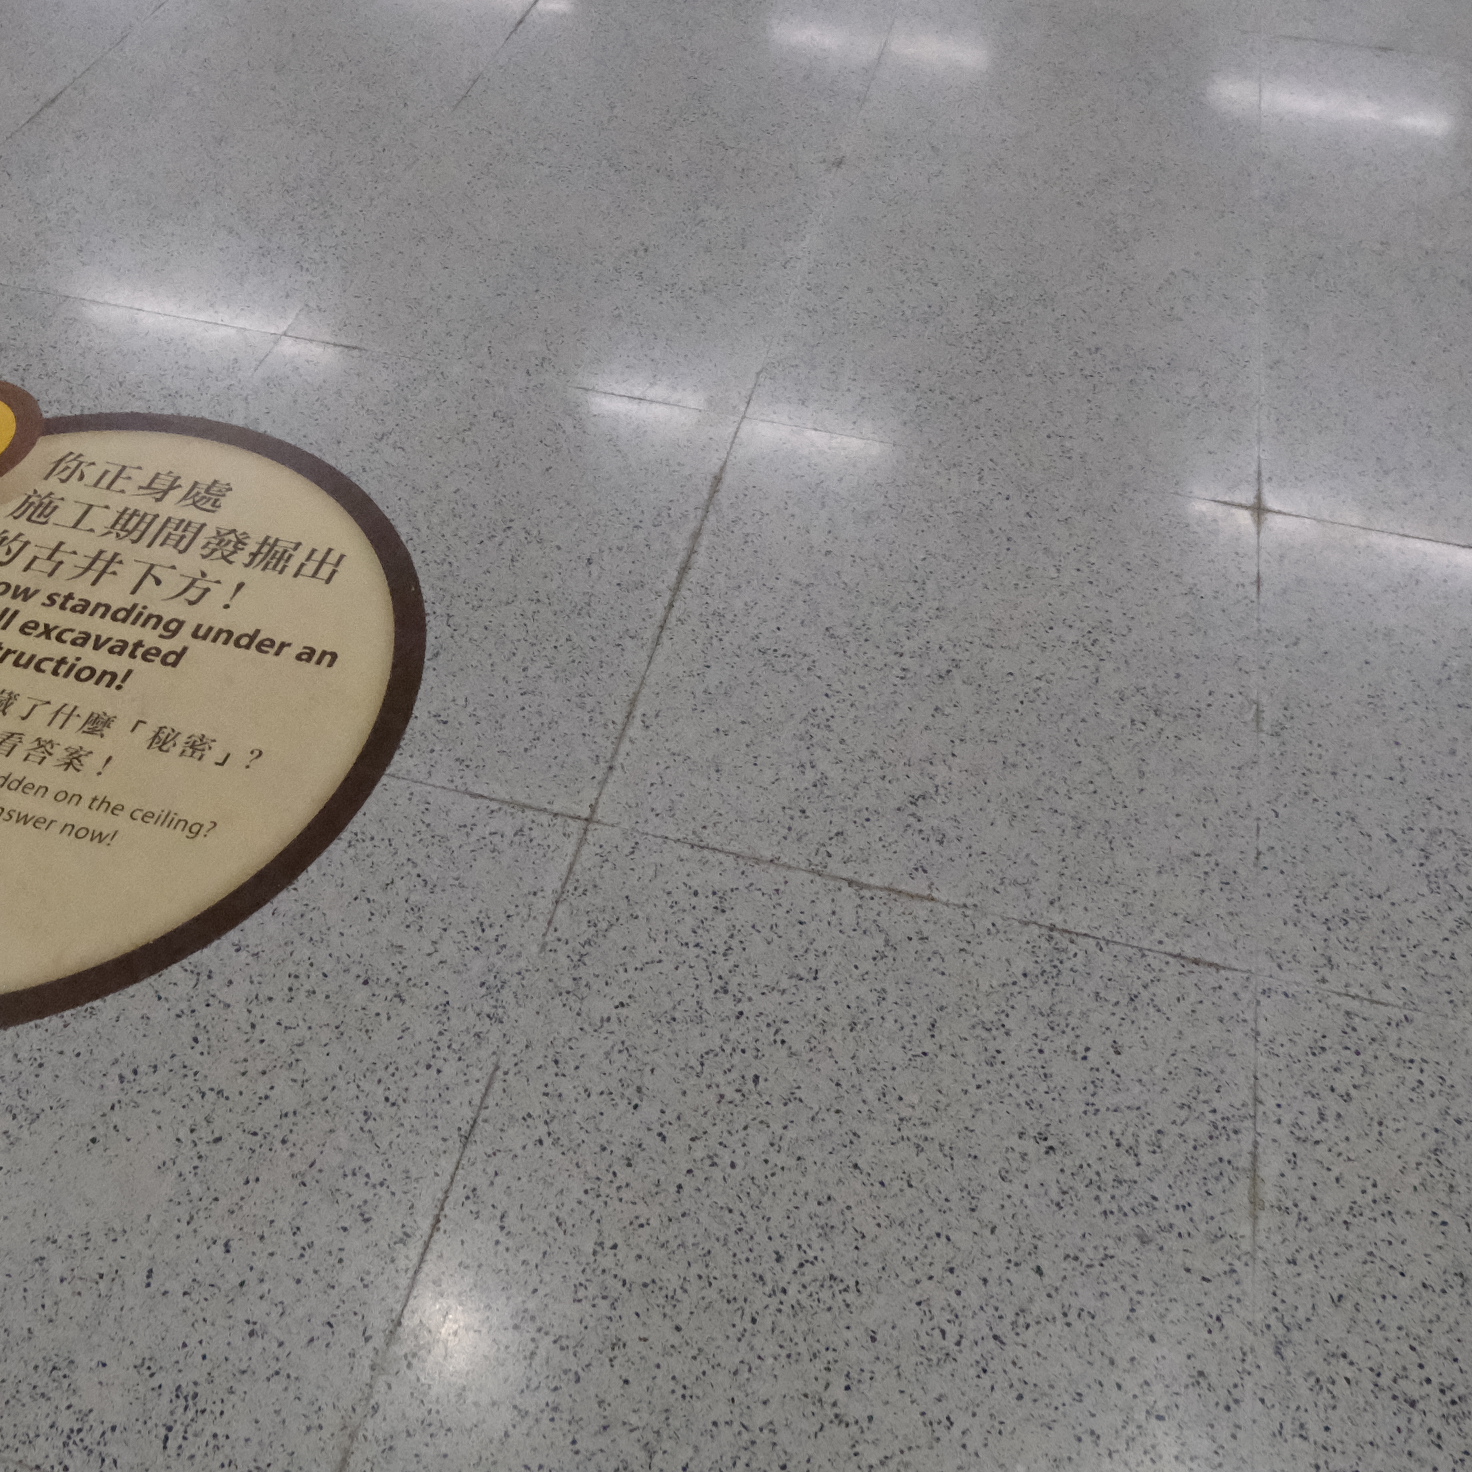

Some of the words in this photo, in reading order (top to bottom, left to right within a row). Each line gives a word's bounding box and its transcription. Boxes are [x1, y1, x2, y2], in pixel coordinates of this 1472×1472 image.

[43, 451, 233, 513] 你正身處
[7, 489, 346, 584] 施工期間發掘出
[18, 618, 189, 668] excavated
[41, 591, 186, 640] standing
[191, 623, 293, 657] under
[295, 645, 338, 668] an
[54, 789, 82, 807] on
[88, 795, 125, 817] the
[129, 806, 217, 840] ceiling?
[58, 821, 119, 846] now!
